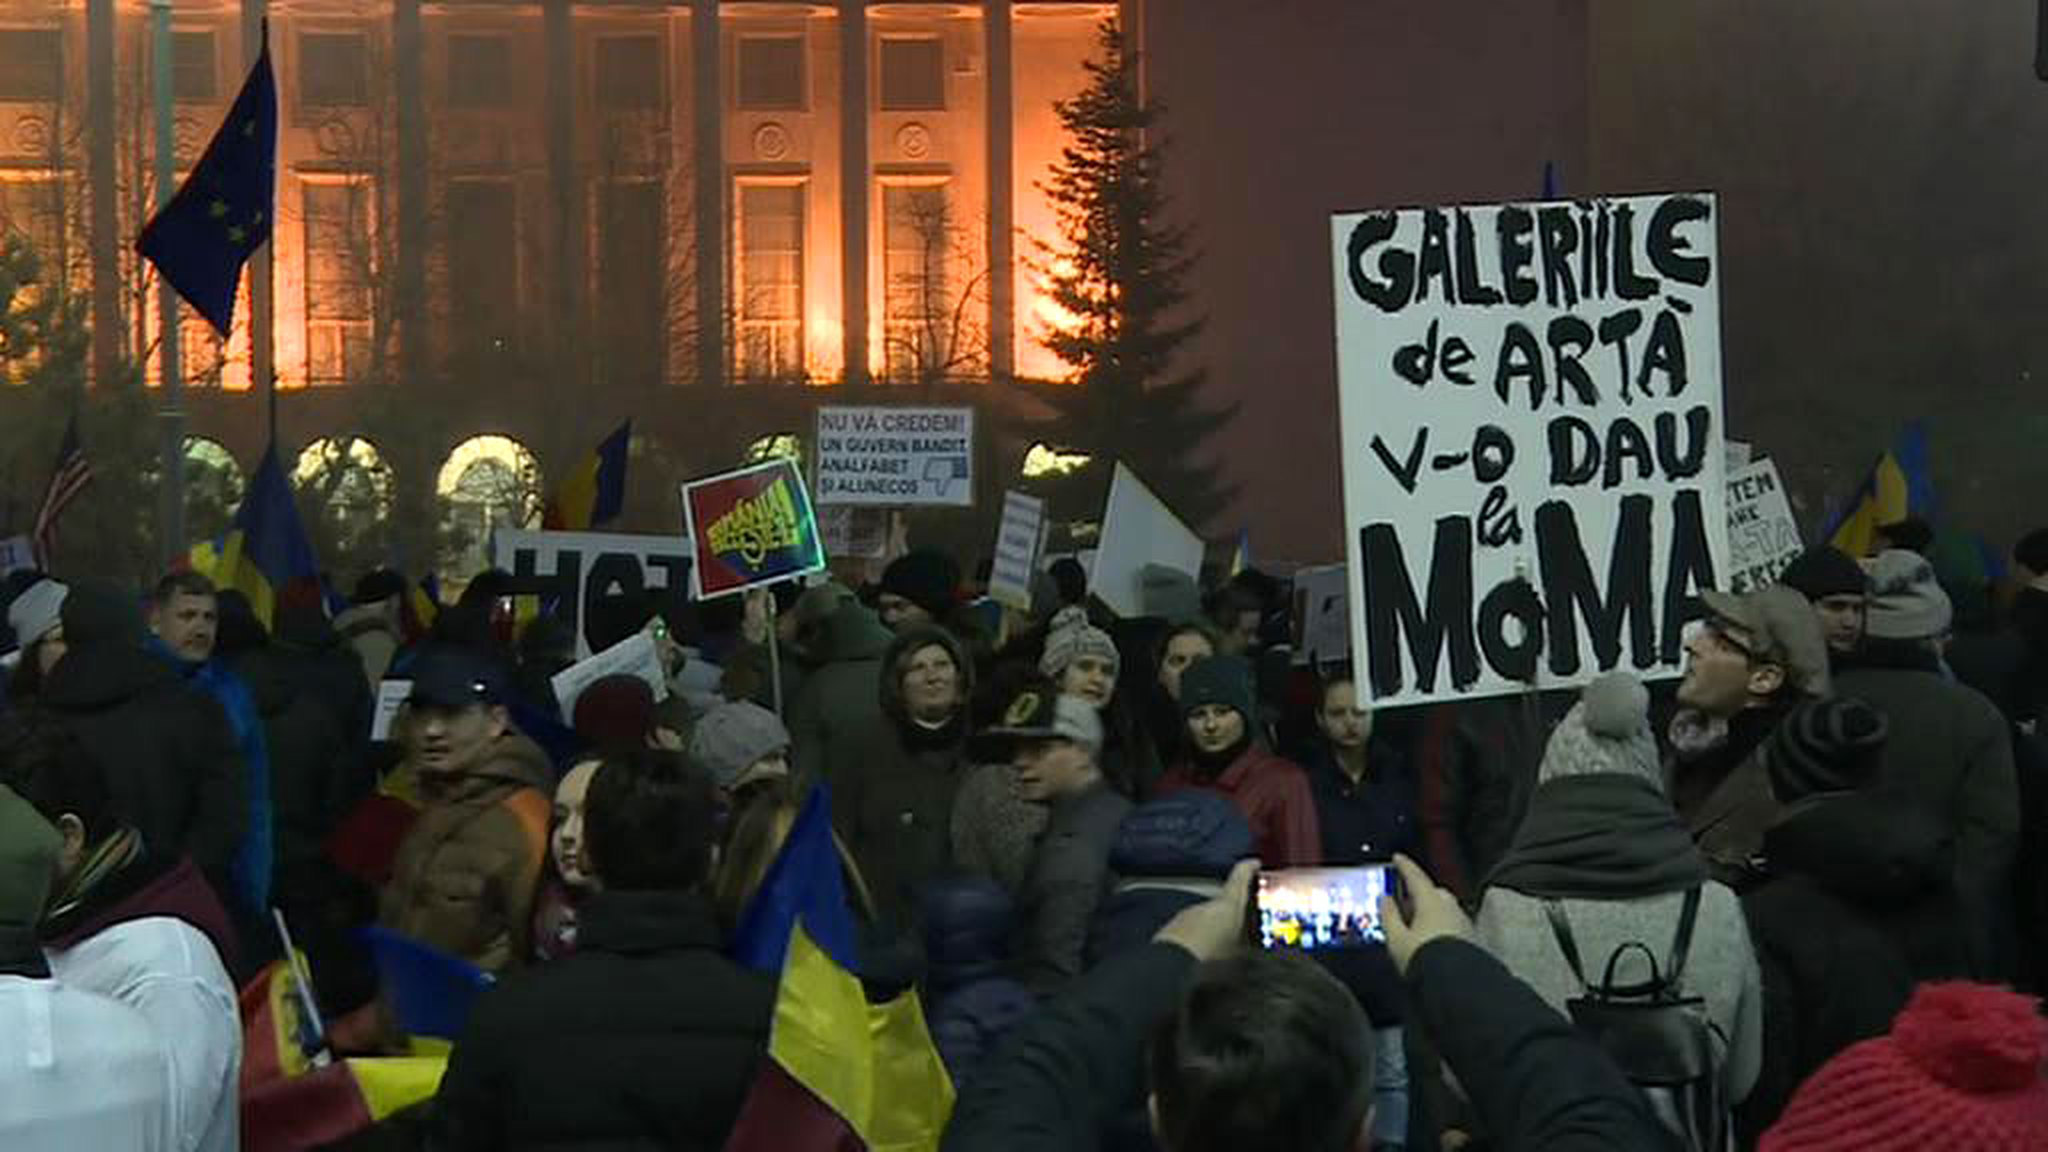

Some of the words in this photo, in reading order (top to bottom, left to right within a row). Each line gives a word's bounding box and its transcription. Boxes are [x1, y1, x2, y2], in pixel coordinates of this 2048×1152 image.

[1347, 194, 1711, 313] GALERIILE
[1393, 318, 1476, 387] de
[821, 414, 848, 431] NU
[821, 438, 842, 452] UN
[846, 438, 908, 452] GUVERN
[821, 457, 909, 473] ANALFABET
[1547, 406, 1710, 490] DAU
[837, 478, 919, 495] ALUNECOS
[1476, 485, 1523, 548] la
